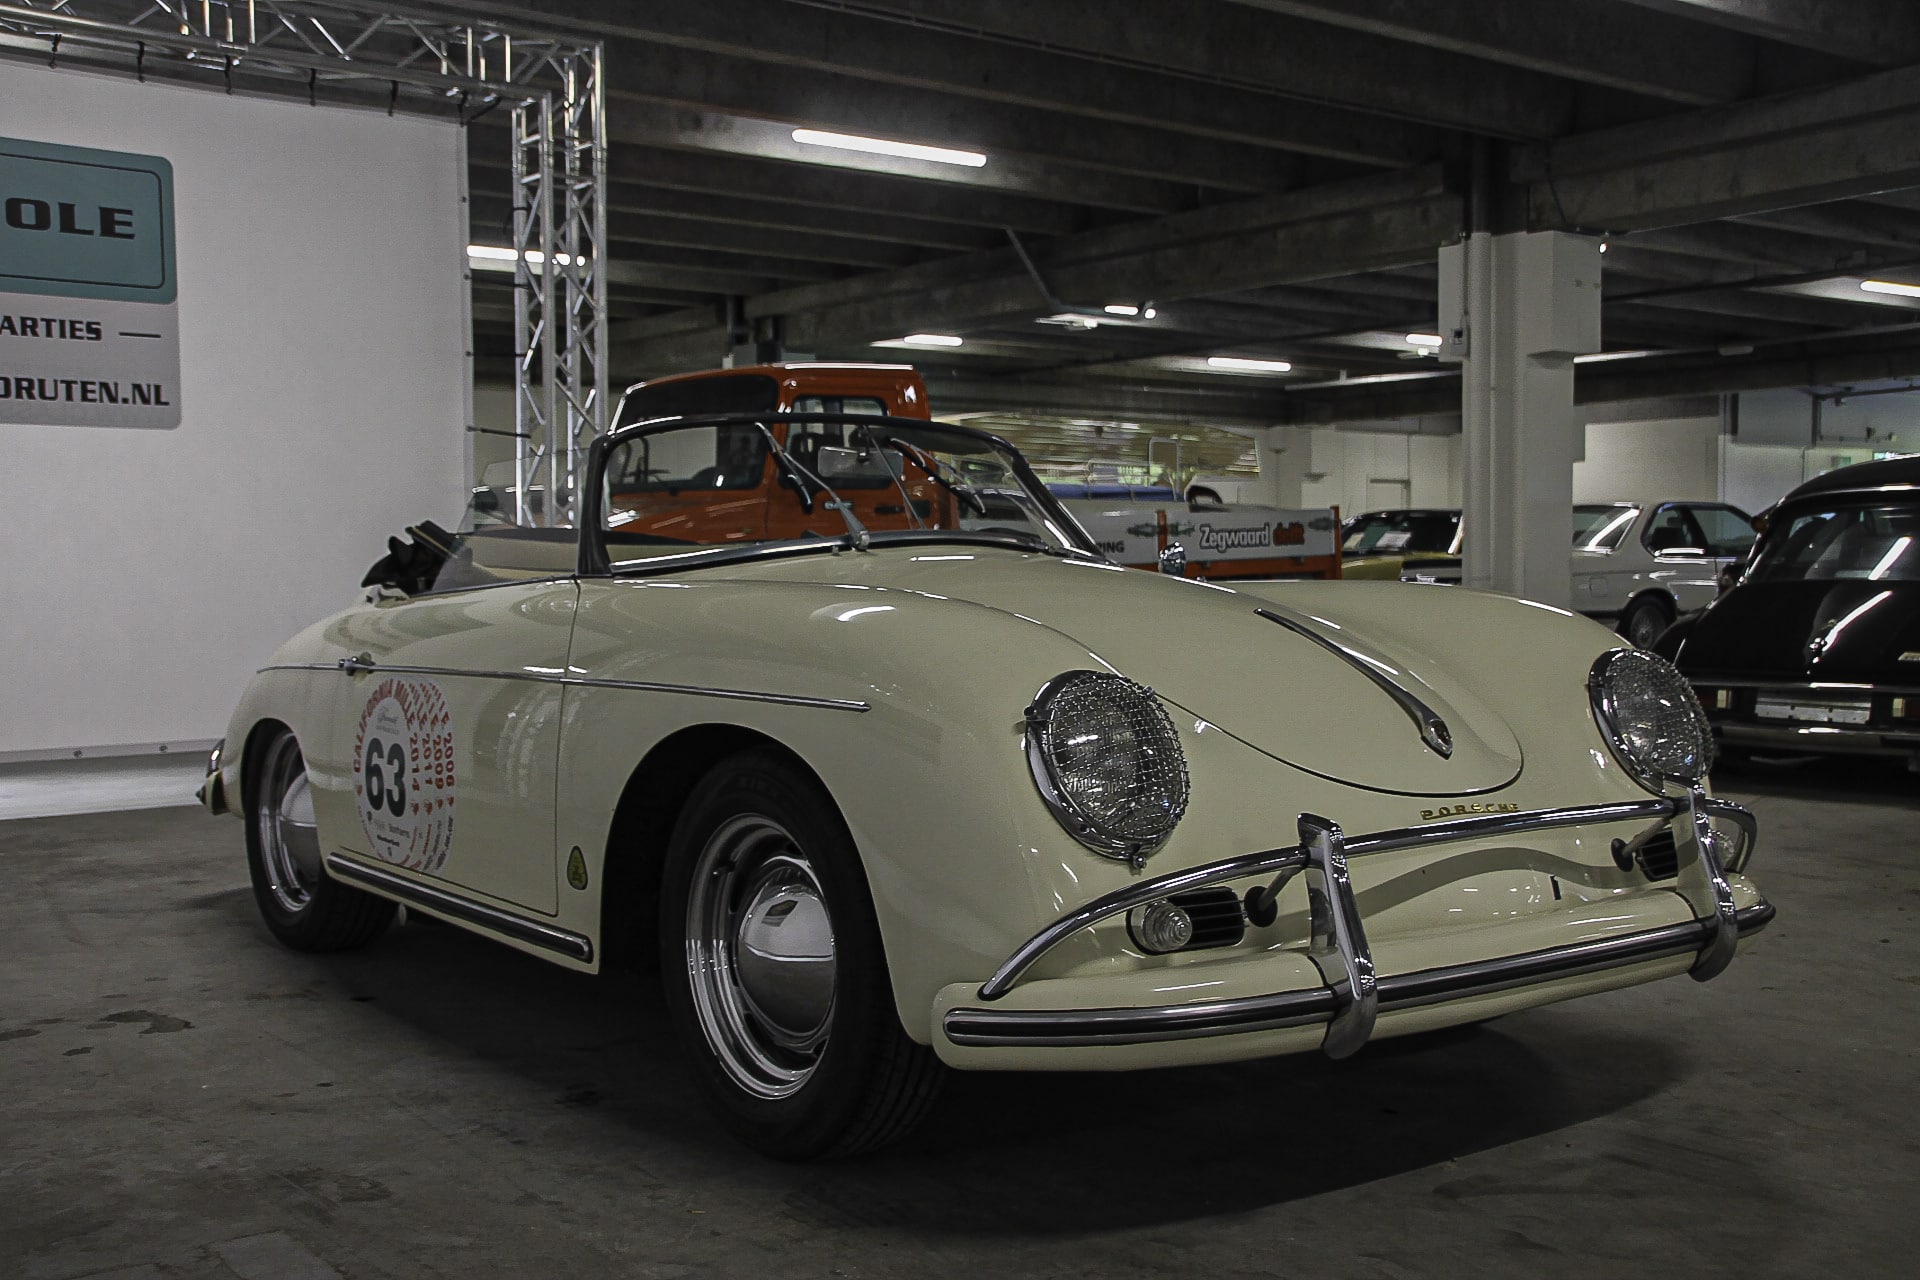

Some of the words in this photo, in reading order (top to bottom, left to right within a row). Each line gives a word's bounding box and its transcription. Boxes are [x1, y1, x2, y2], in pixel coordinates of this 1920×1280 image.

[5, 197, 135, 239] OLE
[0, 315, 102, 341] ARTIES
[1199, 522, 1270, 553] Zegwaard
[365, 737, 406, 818] 63
[1420, 802, 1520, 821] PORSCHE
